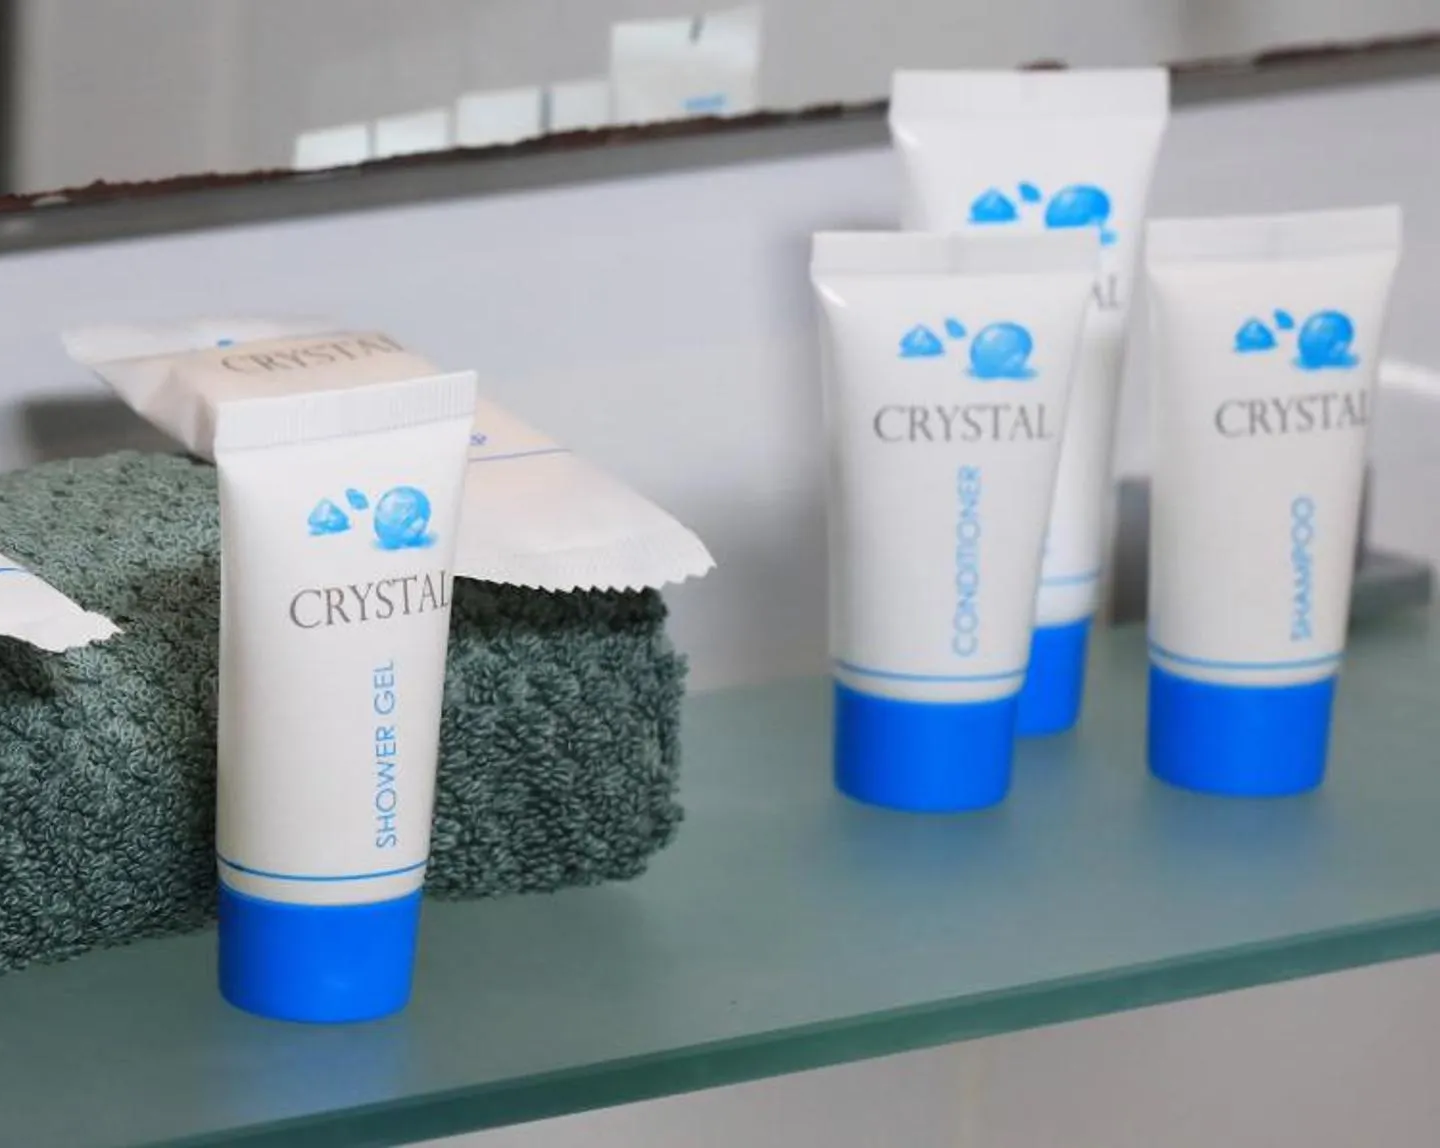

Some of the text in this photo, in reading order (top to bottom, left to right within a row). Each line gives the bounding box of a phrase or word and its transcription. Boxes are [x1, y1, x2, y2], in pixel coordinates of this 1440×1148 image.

[872, 402, 1055, 442] CRYSTAL
[1214, 388, 1372, 438] CRYSTAL
[289, 570, 450, 629] CRYSTAL
[952, 464, 981, 657] CONDITIONER
[1290, 496, 1315, 642] SHAMPOO
[372, 658, 397, 849] SHOWER GEL
